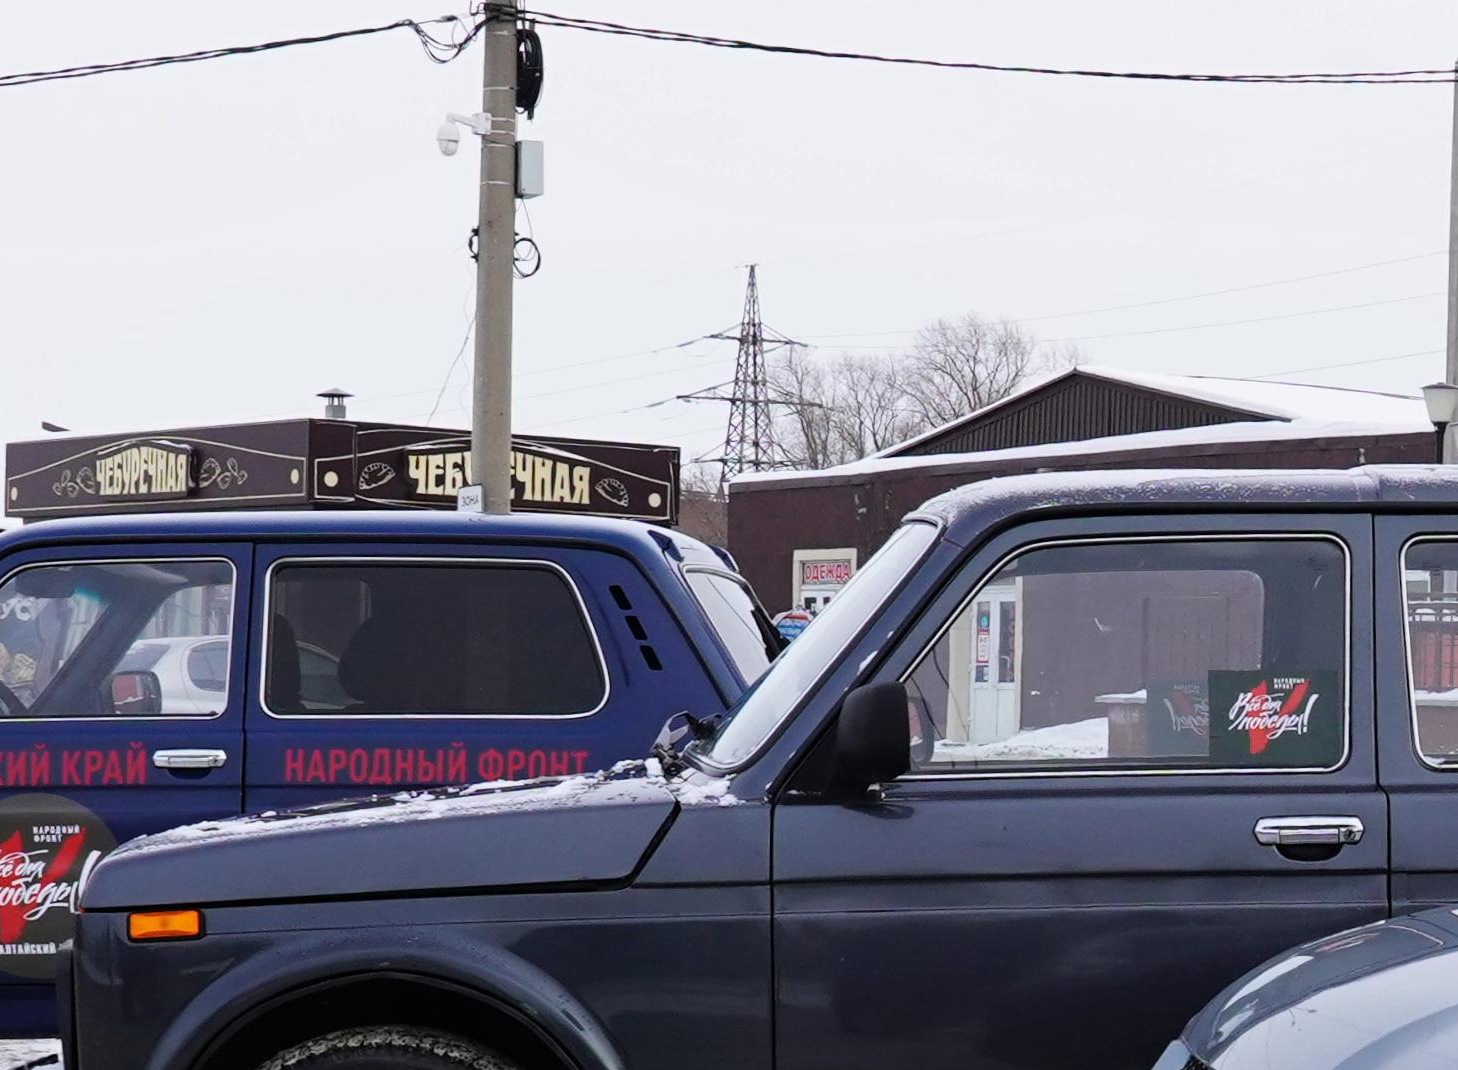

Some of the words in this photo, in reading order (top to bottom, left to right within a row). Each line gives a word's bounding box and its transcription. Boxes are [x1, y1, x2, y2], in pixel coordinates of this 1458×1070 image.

[95, 445, 187, 496] ЧЕБУРЕЧНАЯ
[408, 450, 591, 505] ЧЕБЧНАЯ
[804, 563, 852, 580] ОДЕЖДА
[61, 741, 146, 786] КРАЙ
[284, 741, 467, 786] НАРОДНЫЙ
[477, 747, 590, 780] ФРОНТ
